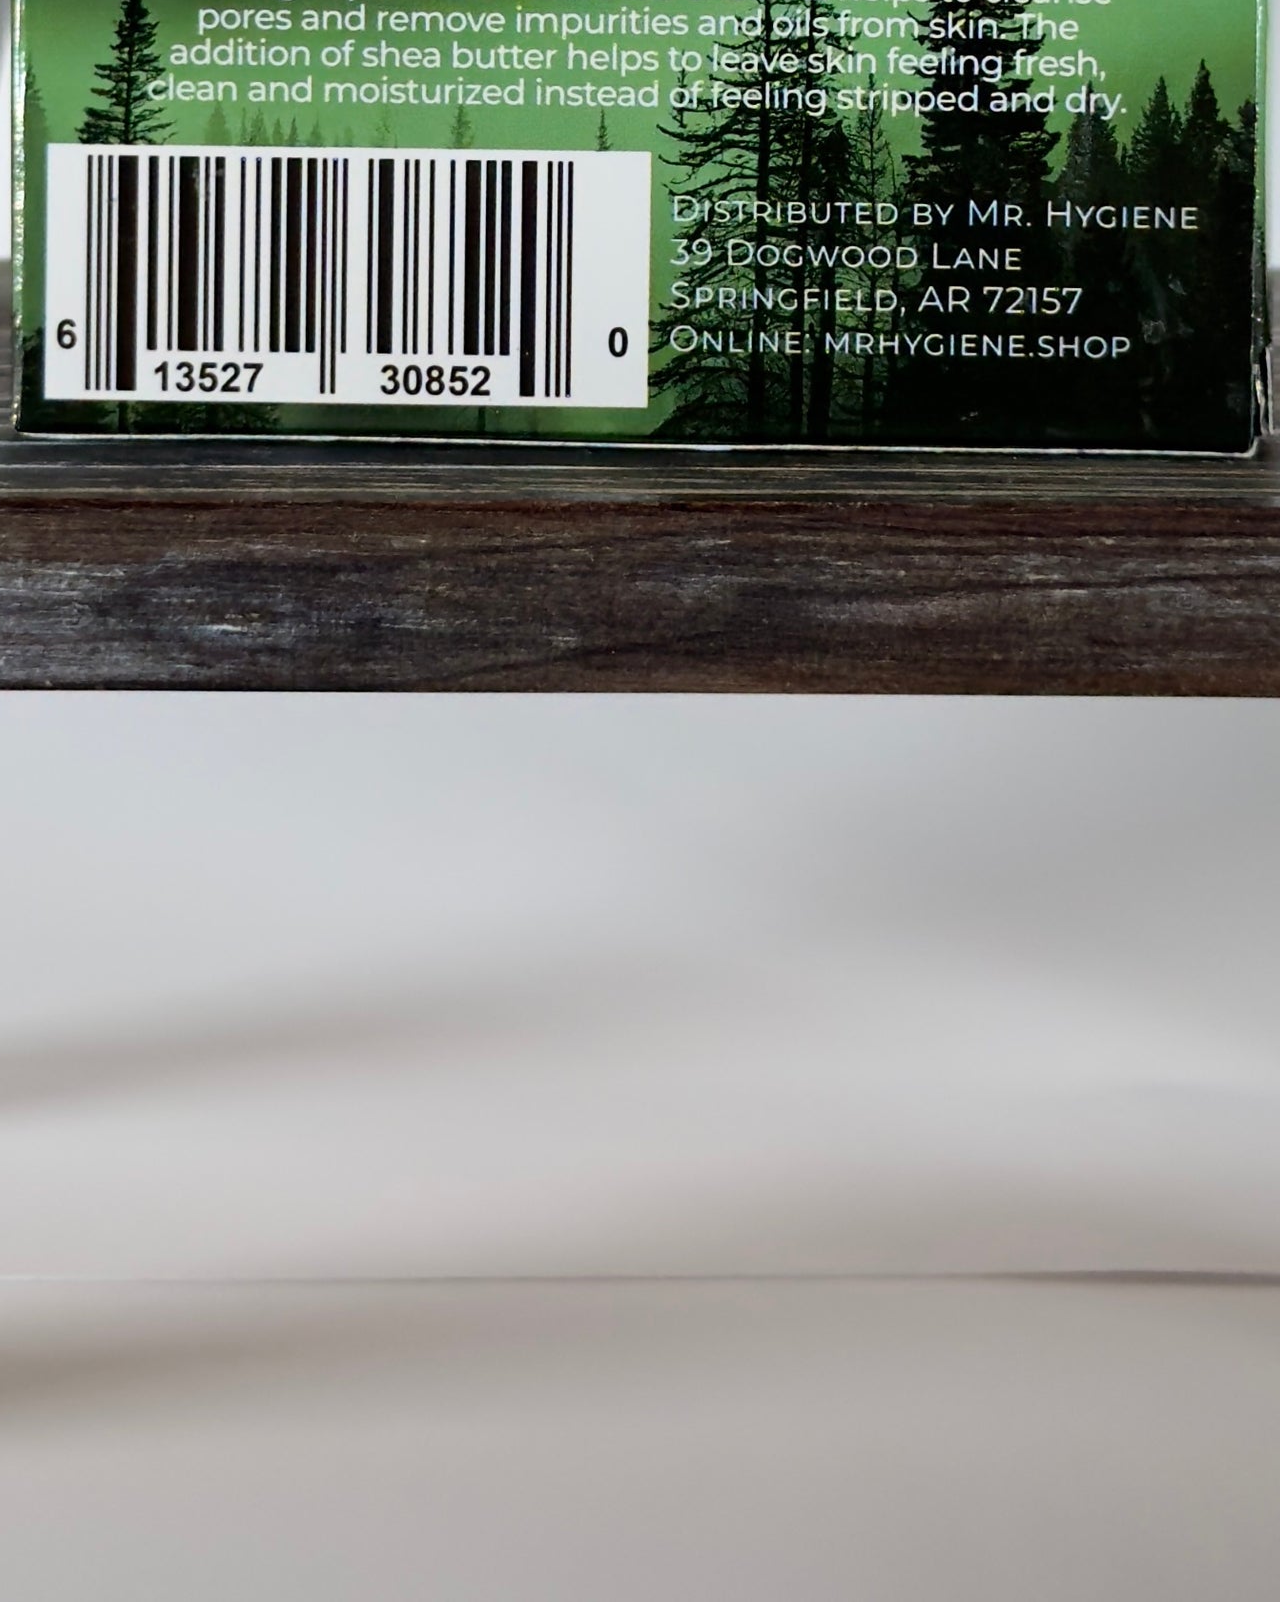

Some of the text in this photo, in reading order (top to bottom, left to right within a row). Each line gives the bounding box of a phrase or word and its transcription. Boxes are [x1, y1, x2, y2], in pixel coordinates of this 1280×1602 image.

[199, 5, 1079, 40] pores and remove impurities and oils from skin. The
[170, 39, 1106, 82] addition of shea butter helps to leave skin feeling fresh,
[147, 74, 1126, 117] clean and moisturized instead of feeling stripped and dry.
[670, 239, 712, 267] 39
[919, 285, 970, 314] AR
[983, 286, 1083, 316] 72157
[56, 319, 78, 350] 6
[608, 327, 629, 358] 0
[154, 362, 491, 396] 13527 30852
